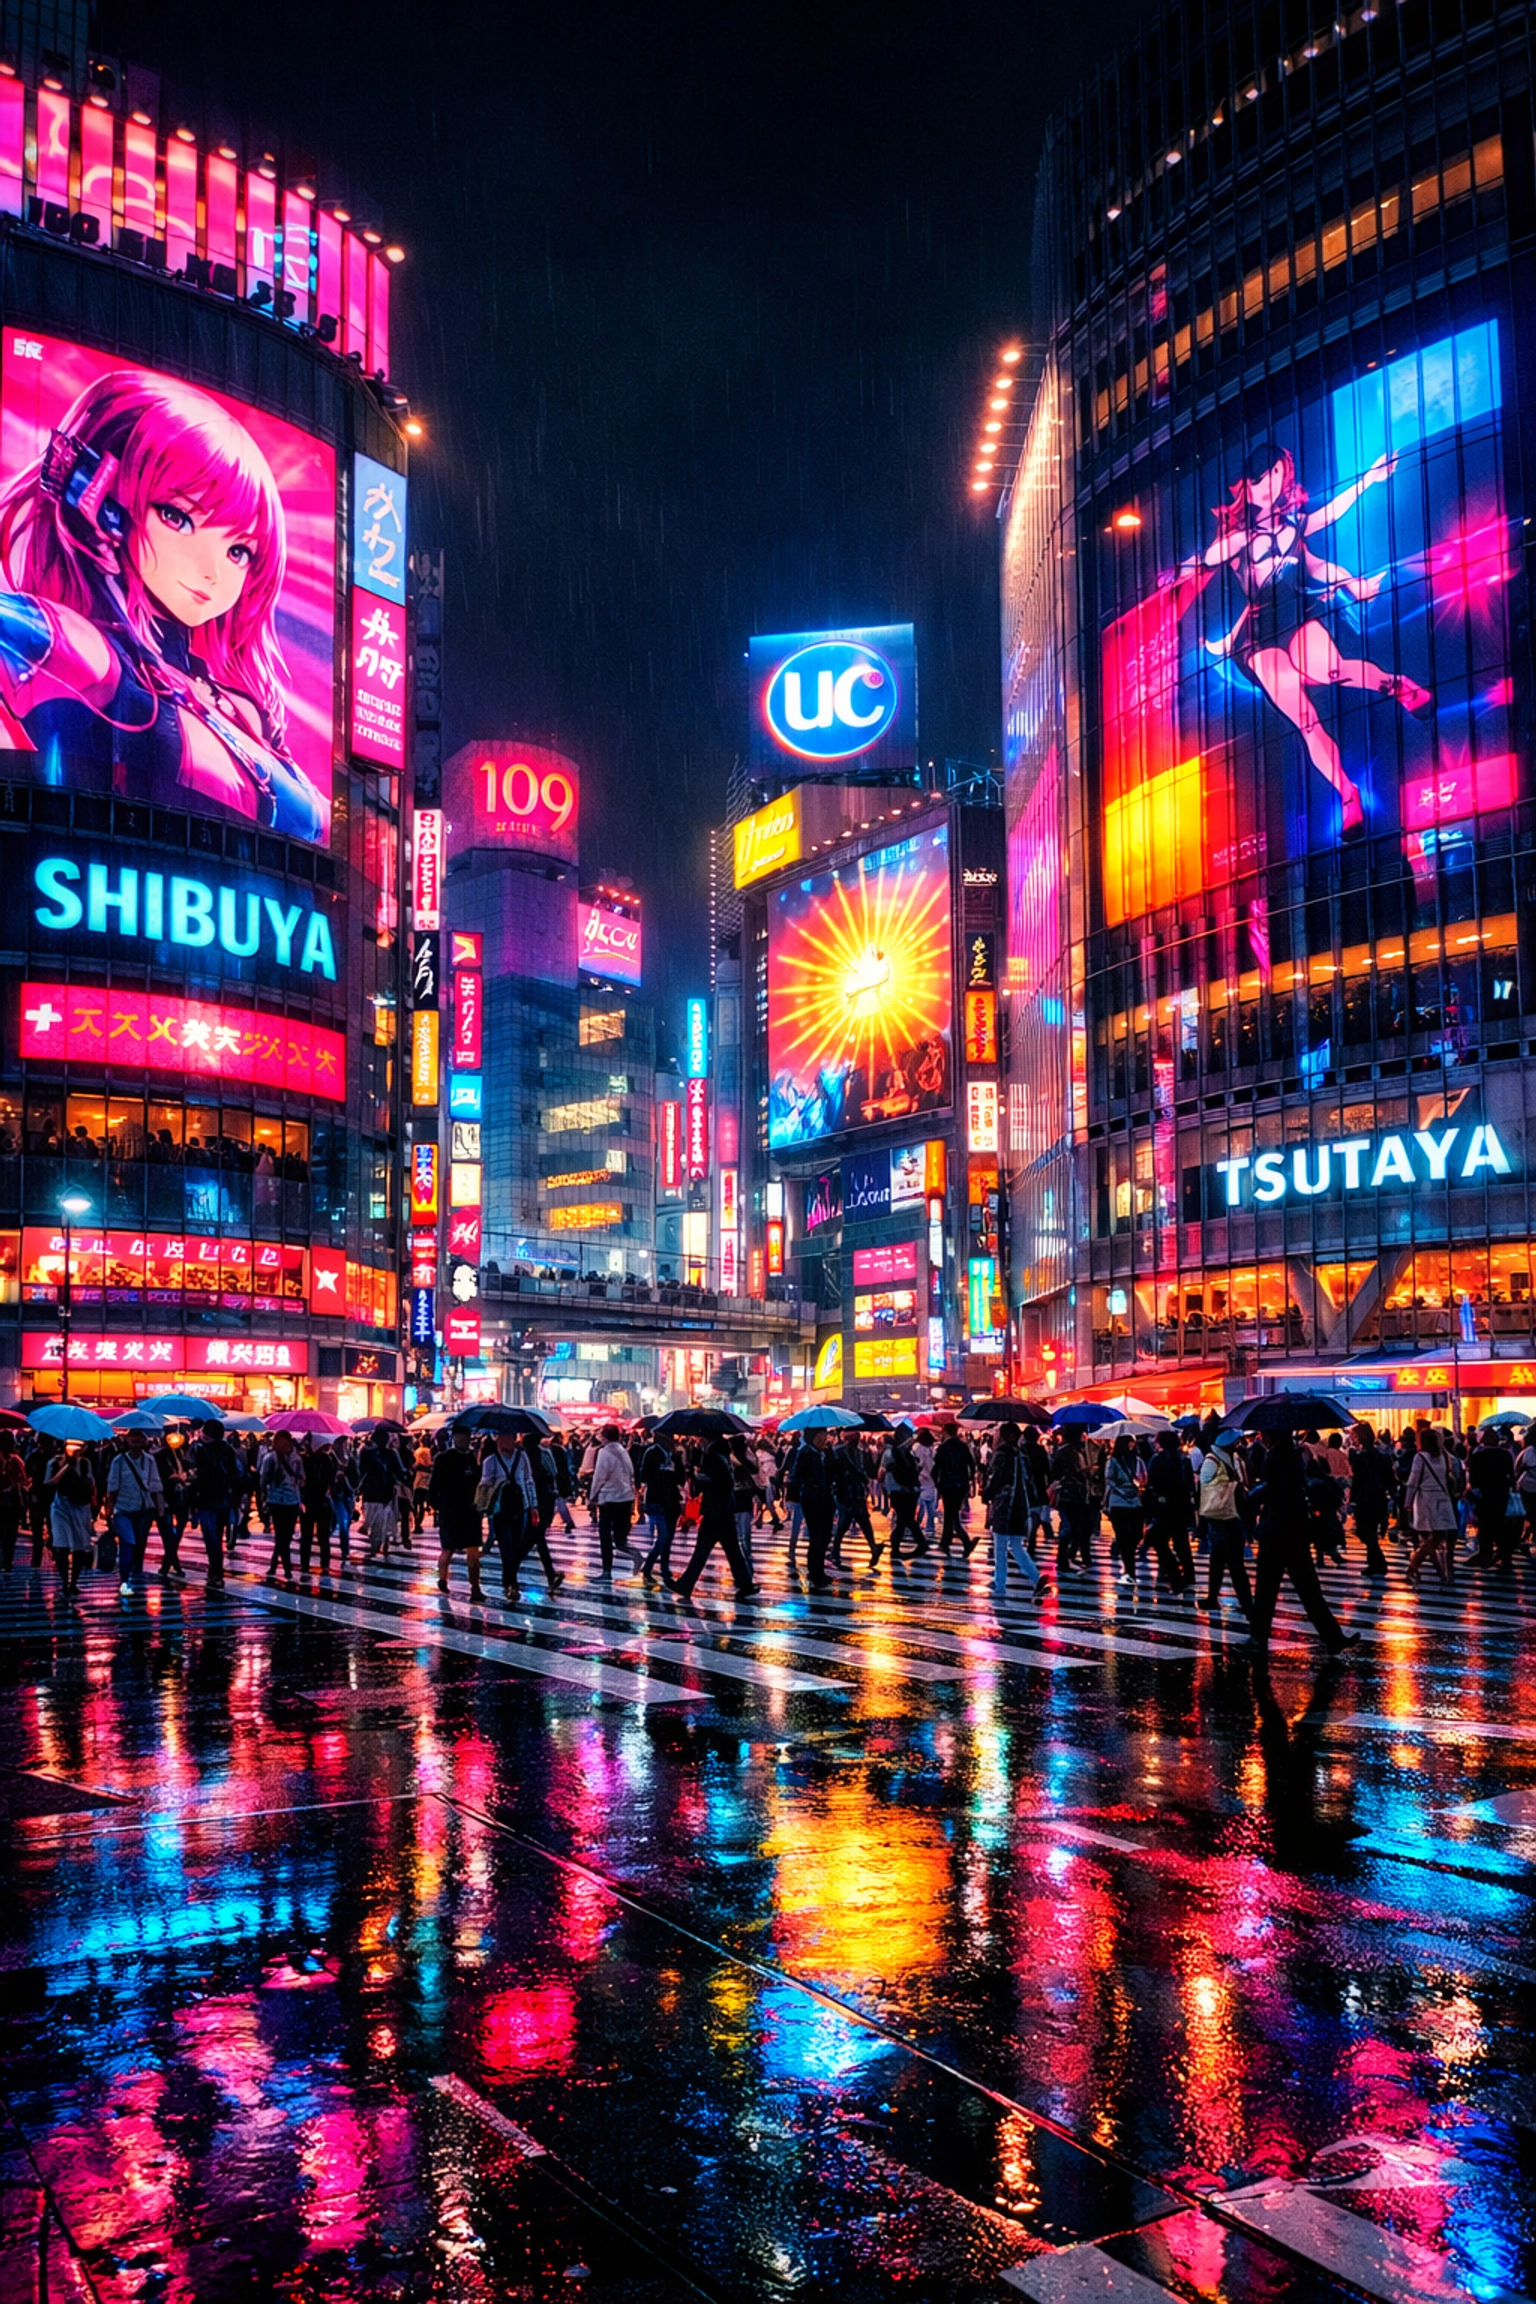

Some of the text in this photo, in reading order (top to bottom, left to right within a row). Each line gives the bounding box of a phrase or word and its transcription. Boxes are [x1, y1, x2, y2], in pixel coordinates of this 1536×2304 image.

[480, 760, 574, 832] 109
[34, 857, 338, 982] SHIBUYA
[1216, 1123, 1512, 1206] TSUTAYA
